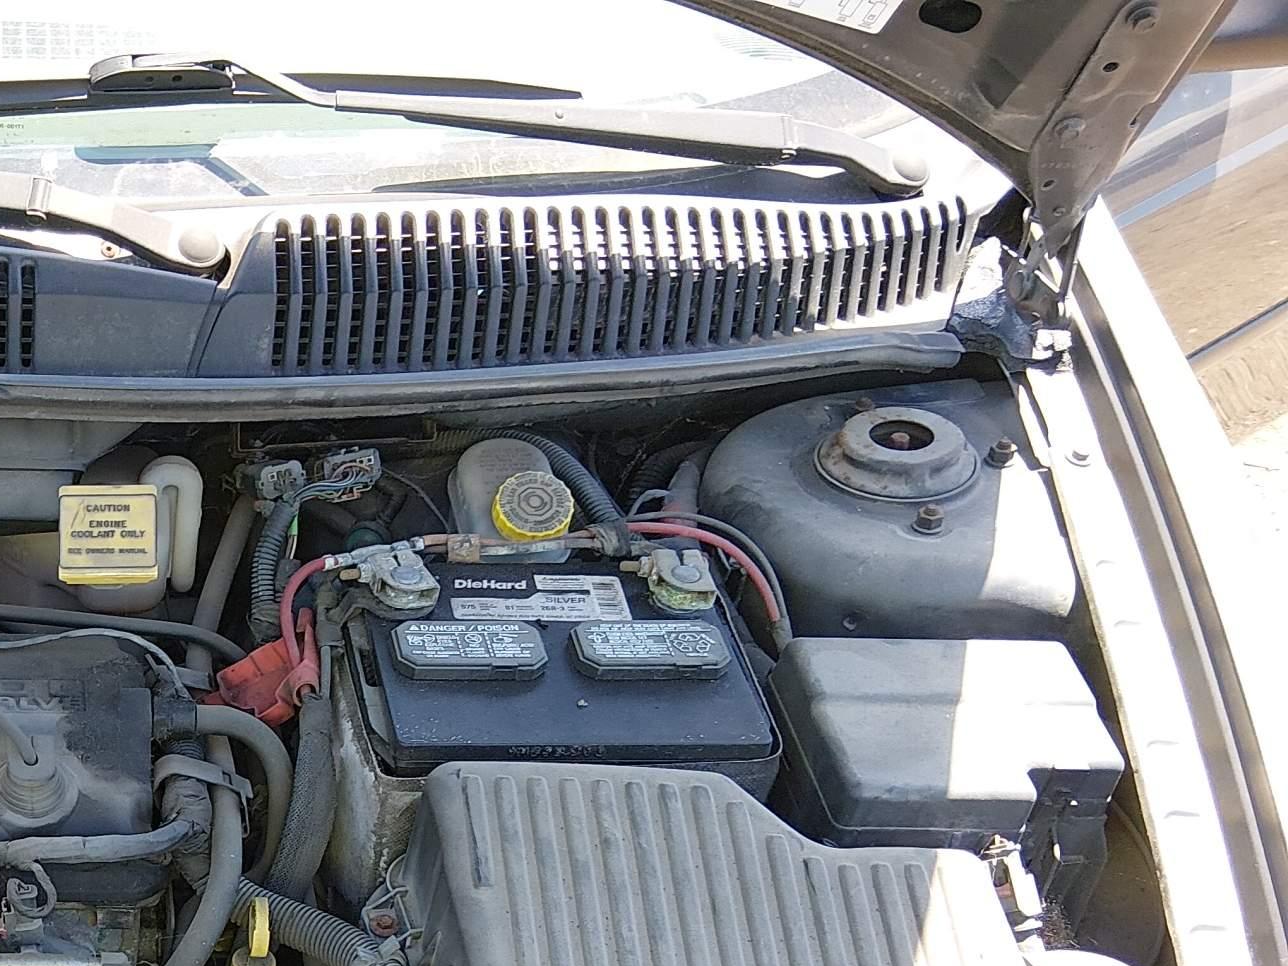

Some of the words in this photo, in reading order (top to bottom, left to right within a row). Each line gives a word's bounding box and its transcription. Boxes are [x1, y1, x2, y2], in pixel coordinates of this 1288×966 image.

[86, 504, 130, 512] CAUTION
[89, 520, 127, 528] ENGINE
[71, 530, 115, 538] COOLANT
[120, 530, 146, 538] ONLY
[454, 579, 527, 590] DieHard
[546, 596, 586, 604] SILVER
